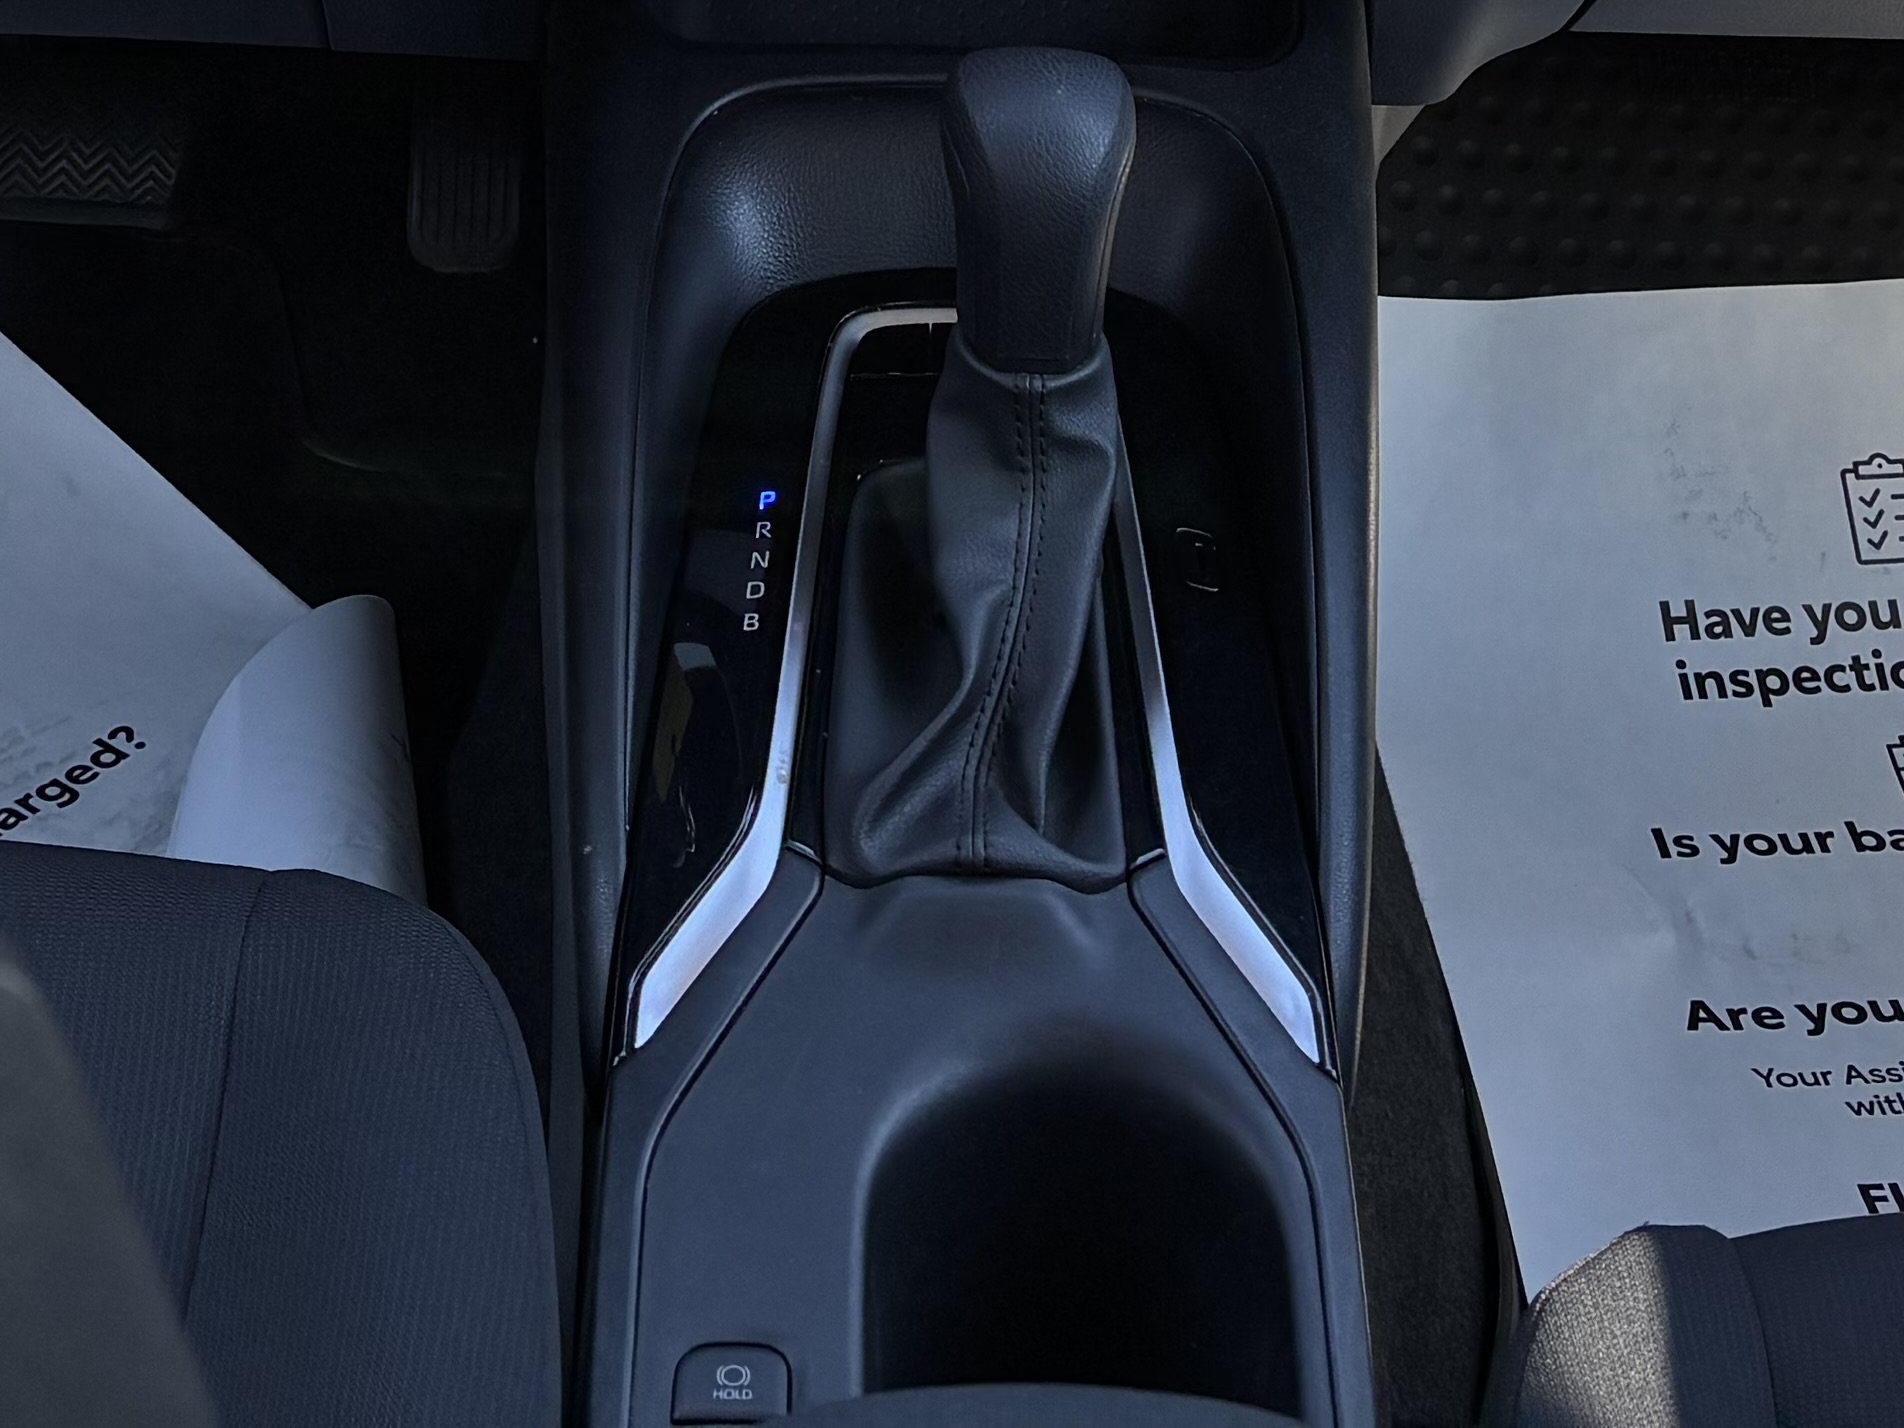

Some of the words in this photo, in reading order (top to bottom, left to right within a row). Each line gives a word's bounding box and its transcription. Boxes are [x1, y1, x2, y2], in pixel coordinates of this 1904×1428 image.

[759, 491, 776, 510] P
[755, 521, 772, 539] R
[750, 550, 770, 569] N
[746, 581, 765, 599] D
[743, 613, 759, 631] B
[1659, 599, 1791, 643] Have
[1802, 597, 1902, 646] you
[1651, 827, 1700, 860] Is
[1709, 830, 1838, 865] your
[1686, 998, 1786, 1031] Are
[1751, 1067, 1833, 1089] Your
[712, 1388, 753, 1400] HOLD
